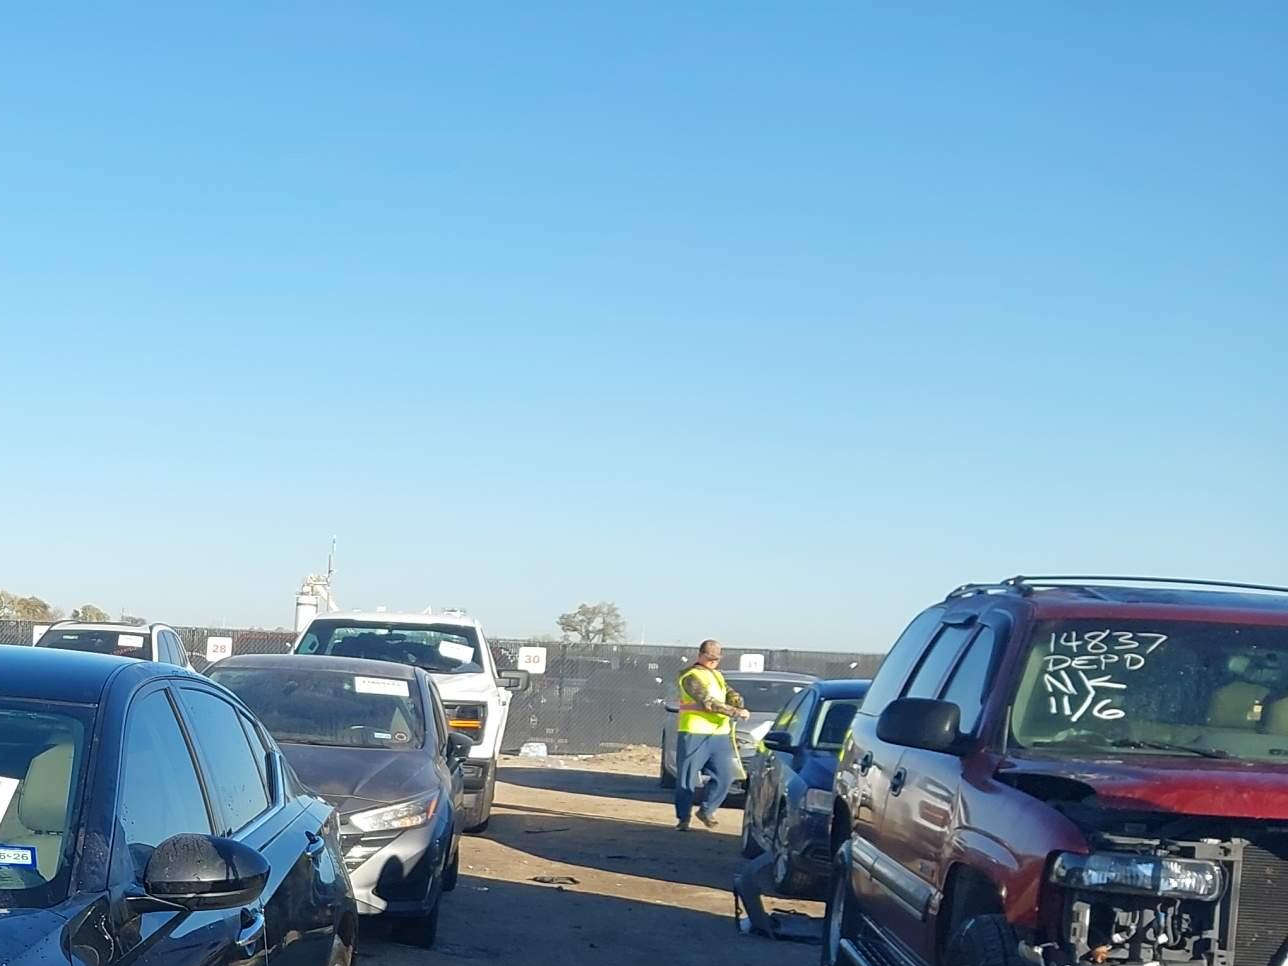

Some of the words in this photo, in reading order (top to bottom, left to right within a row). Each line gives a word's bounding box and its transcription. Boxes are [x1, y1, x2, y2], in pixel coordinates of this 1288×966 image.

[1049, 629, 1168, 655] 14837
[212, 644, 226, 654] 28
[524, 654, 540, 665] 30
